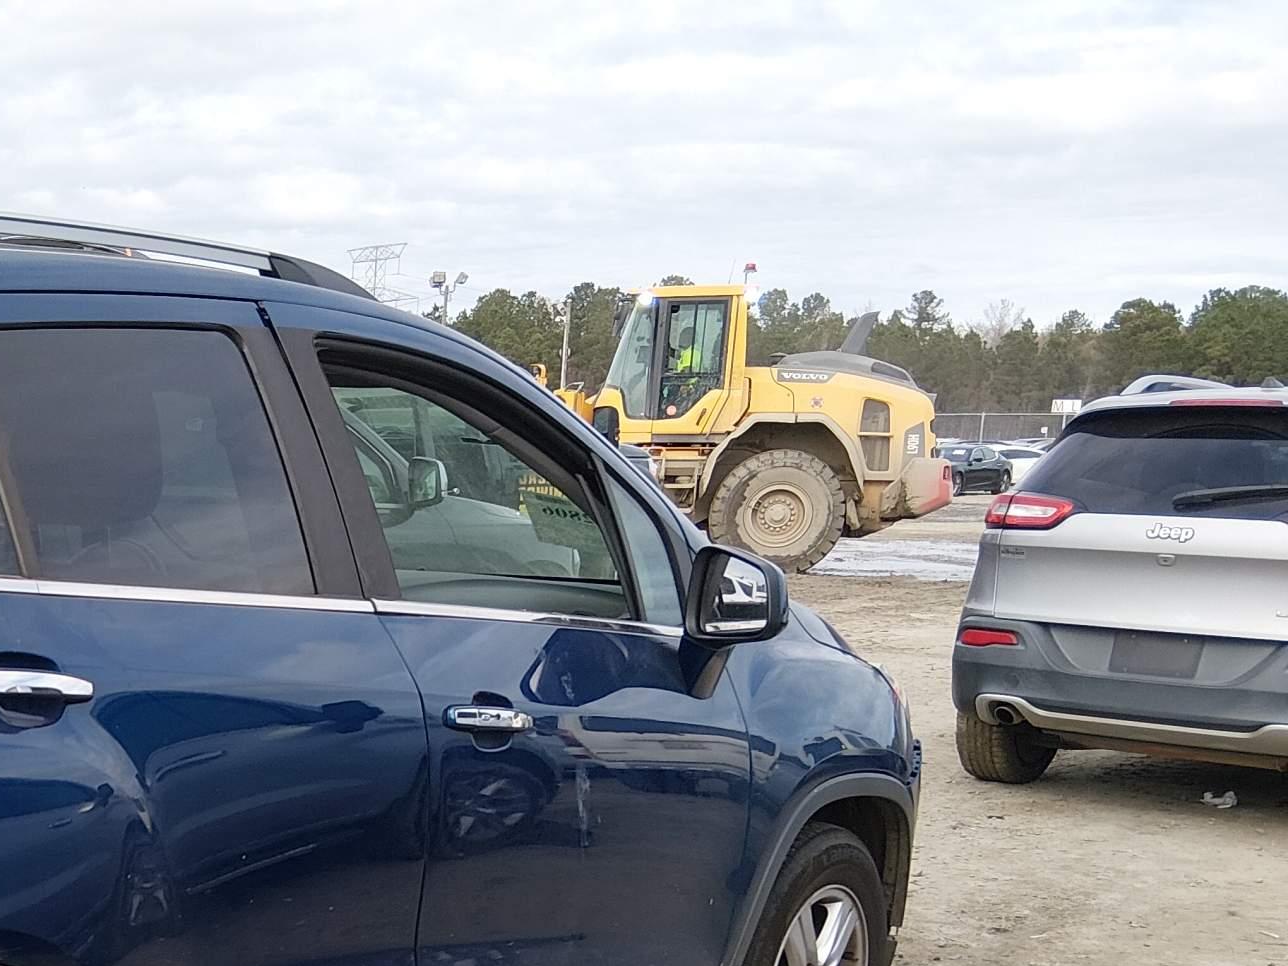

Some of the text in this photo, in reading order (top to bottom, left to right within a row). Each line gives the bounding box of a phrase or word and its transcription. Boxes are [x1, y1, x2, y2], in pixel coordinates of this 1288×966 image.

[781, 372, 829, 380] VOLVO
[1053, 400, 1064, 411] M
[1146, 523, 1195, 543] Jeep
